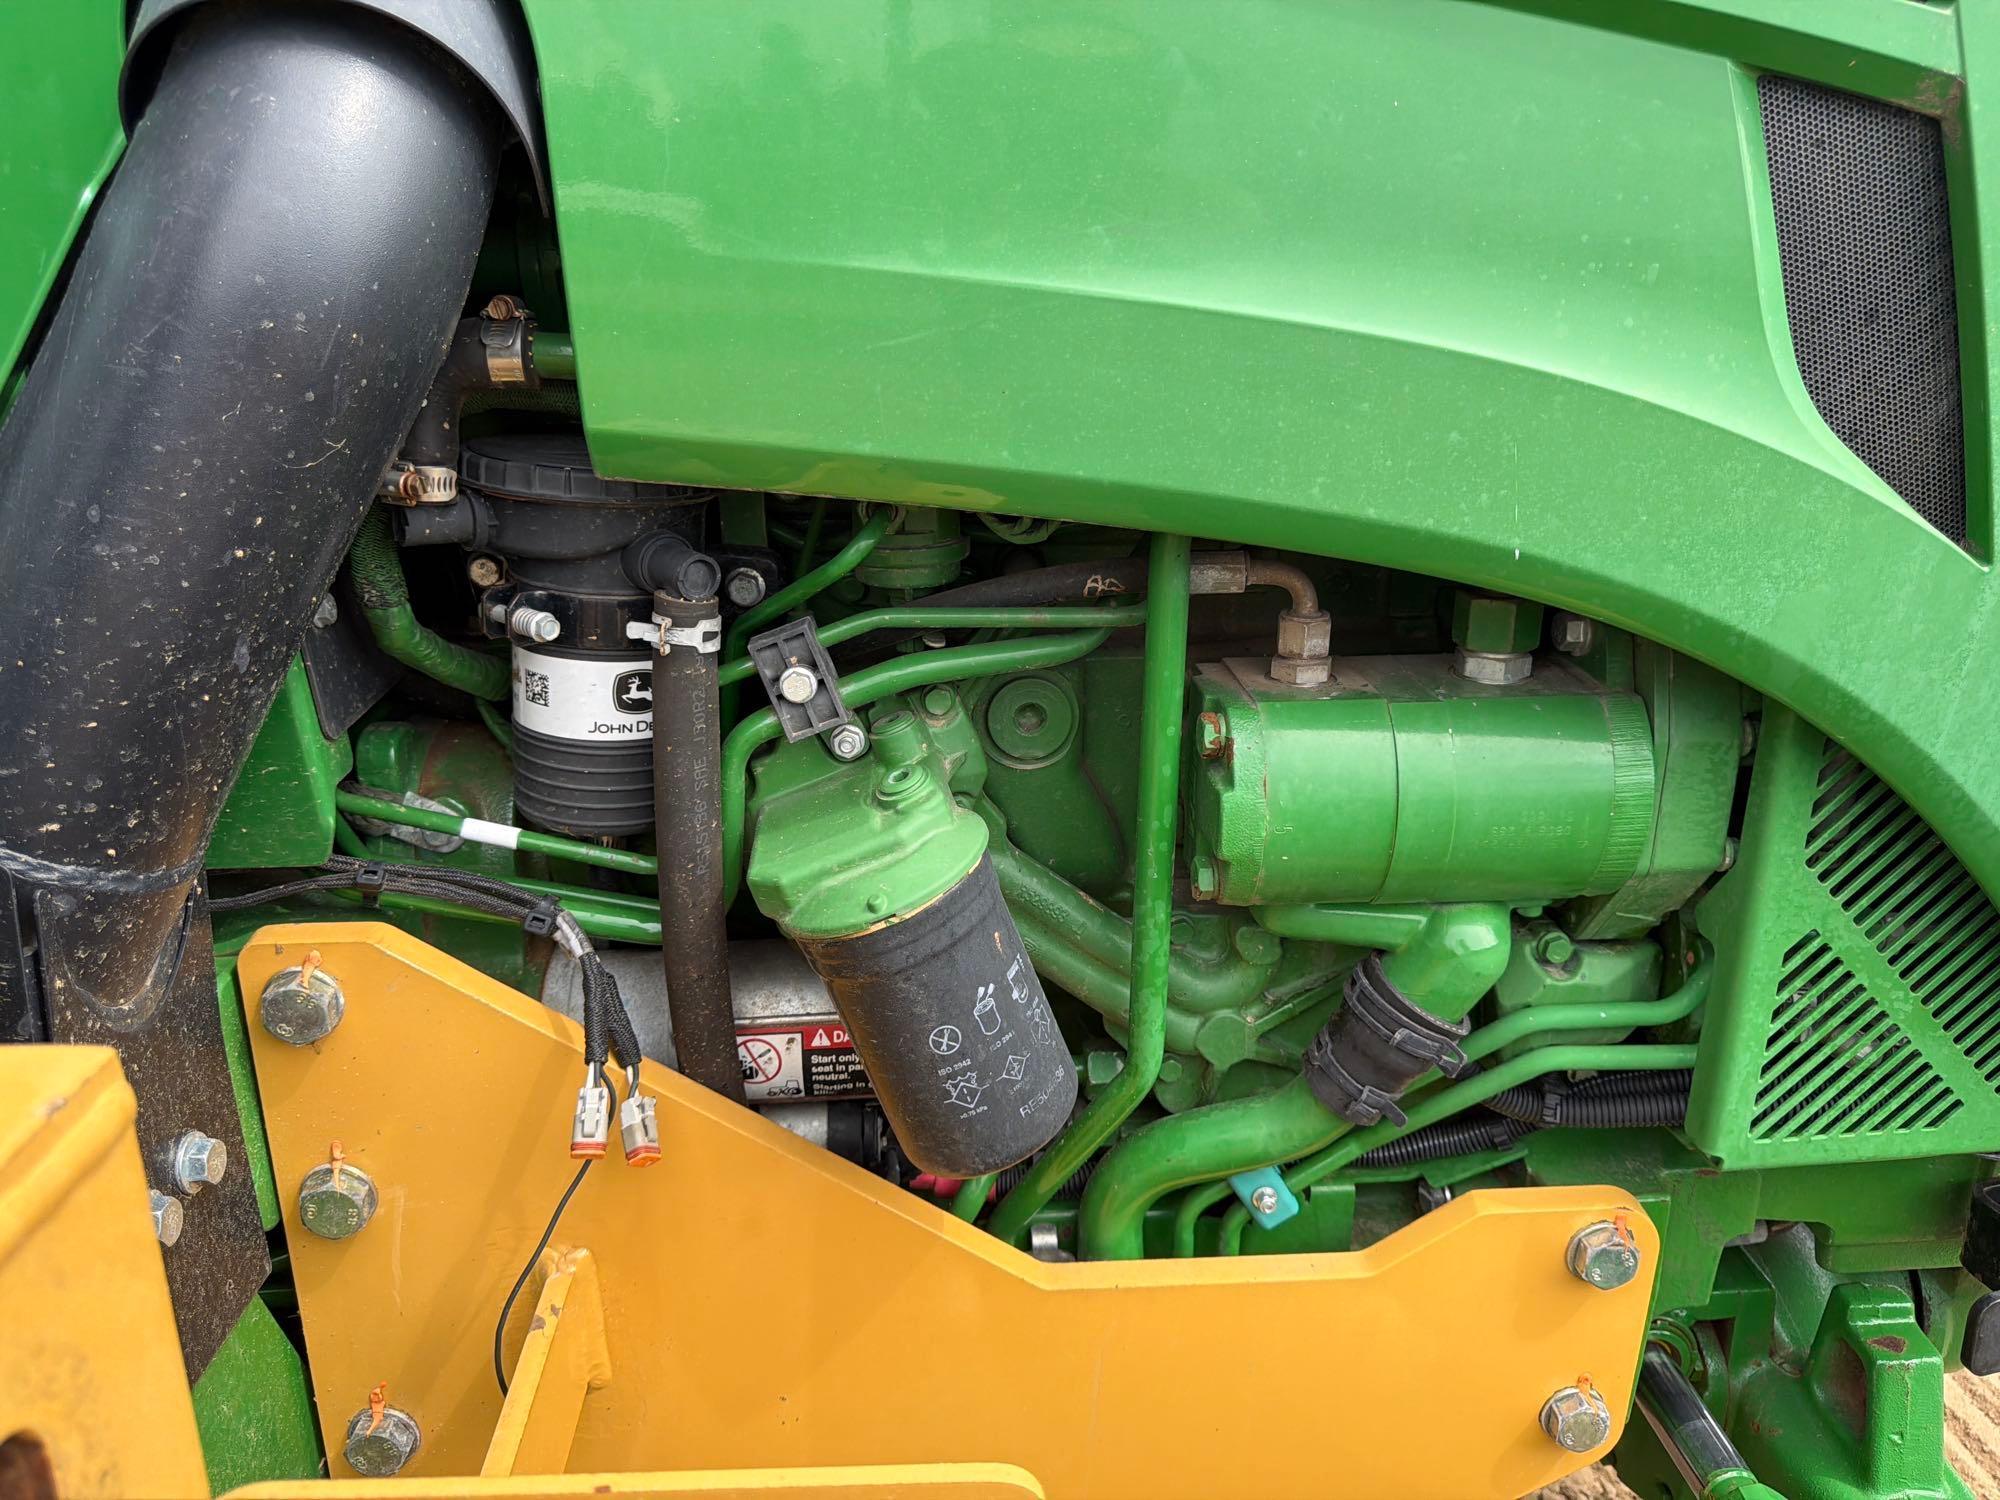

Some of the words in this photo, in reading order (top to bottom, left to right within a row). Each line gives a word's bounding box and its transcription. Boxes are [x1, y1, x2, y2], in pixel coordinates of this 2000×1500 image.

[587, 721, 633, 734] JOHN
[693, 756, 707, 791] SAE
[810, 1054, 836, 1064] Start
[811, 1064, 833, 1073] seat
[937, 1066, 953, 1077] ISO
[953, 1058, 972, 1071] 2942
[811, 1072, 851, 1081] neutral.
[813, 1082, 853, 1091] Starting
